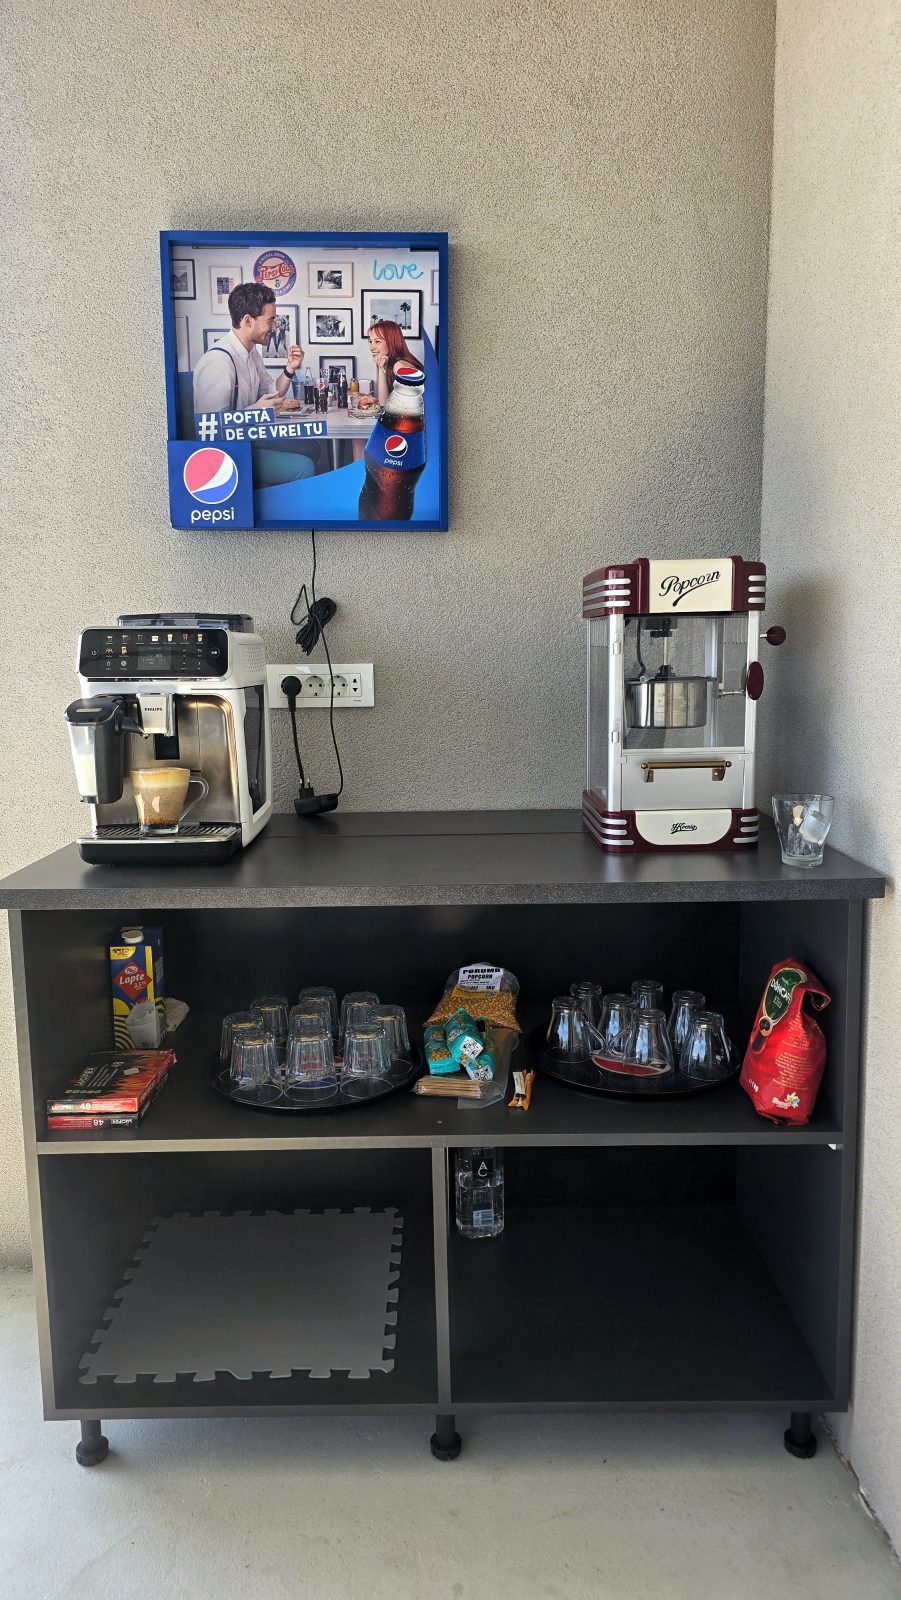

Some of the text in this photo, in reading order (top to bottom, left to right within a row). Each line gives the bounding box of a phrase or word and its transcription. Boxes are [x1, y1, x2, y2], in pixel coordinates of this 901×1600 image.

[372, 259, 424, 281] love
[223, 407, 271, 425] POFTĂ
[225, 422, 323, 441] DE CE VREI TU
[384, 458, 403, 467] pepsi
[191, 506, 235, 524] pepsi
[658, 571, 721, 598] Popcorn
[119, 973, 145, 986] Lapte
